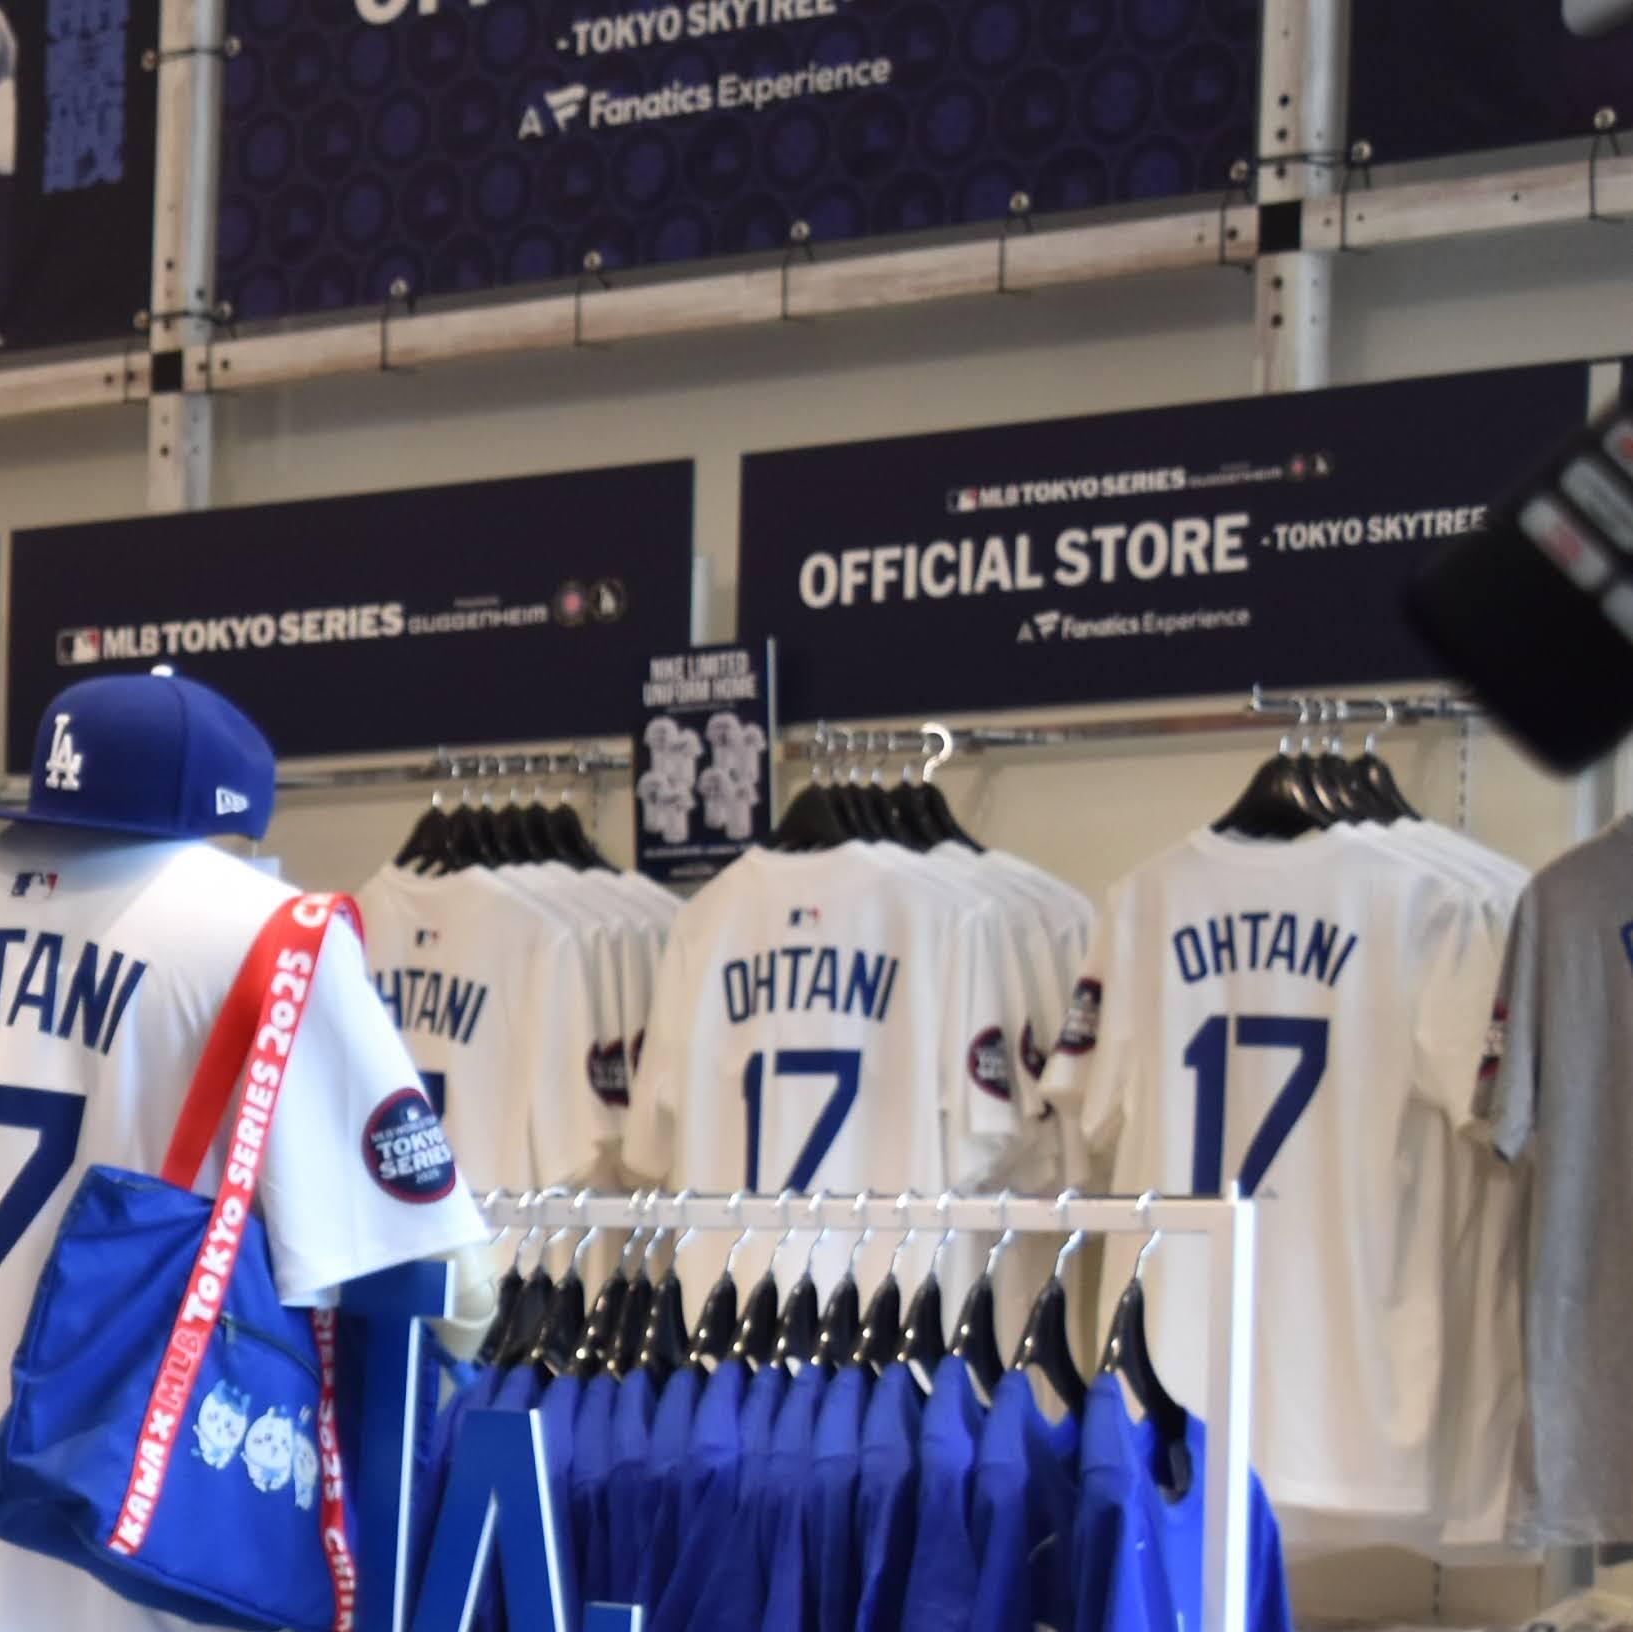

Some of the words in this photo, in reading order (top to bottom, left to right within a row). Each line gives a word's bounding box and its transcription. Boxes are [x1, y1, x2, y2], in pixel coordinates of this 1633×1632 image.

[588, 83, 712, 128] Fanatics
[718, 57, 892, 110] Experience
[1021, 477, 1100, 504] TOKYO
[1101, 467, 1187, 497] SERIES
[798, 533, 1044, 609] OFFICIAL
[1054, 513, 1250, 588] STORE
[103, 626, 161, 661] MLB
[162, 614, 276, 654] TOKYO
[278, 602, 406, 646] SERIES
[408, 605, 548, 636] GUGGENHEIM
[1061, 612, 1140, 639] Fanatics
[1141, 606, 1251, 635] Experience
[45, 713, 83, 791] LA
[722, 946, 900, 1025] OHTANI
[1172, 911, 1359, 988] OHTANI
[375, 967, 489, 1046] HTANI
[183, 1196, 245, 1322] TOKYO
[226, 1058, 281, 1191] SERIES
[256, 948, 313, 1056] 2025
[742, 1048, 863, 1194] 17
[1183, 1014, 1330, 1200] 17
